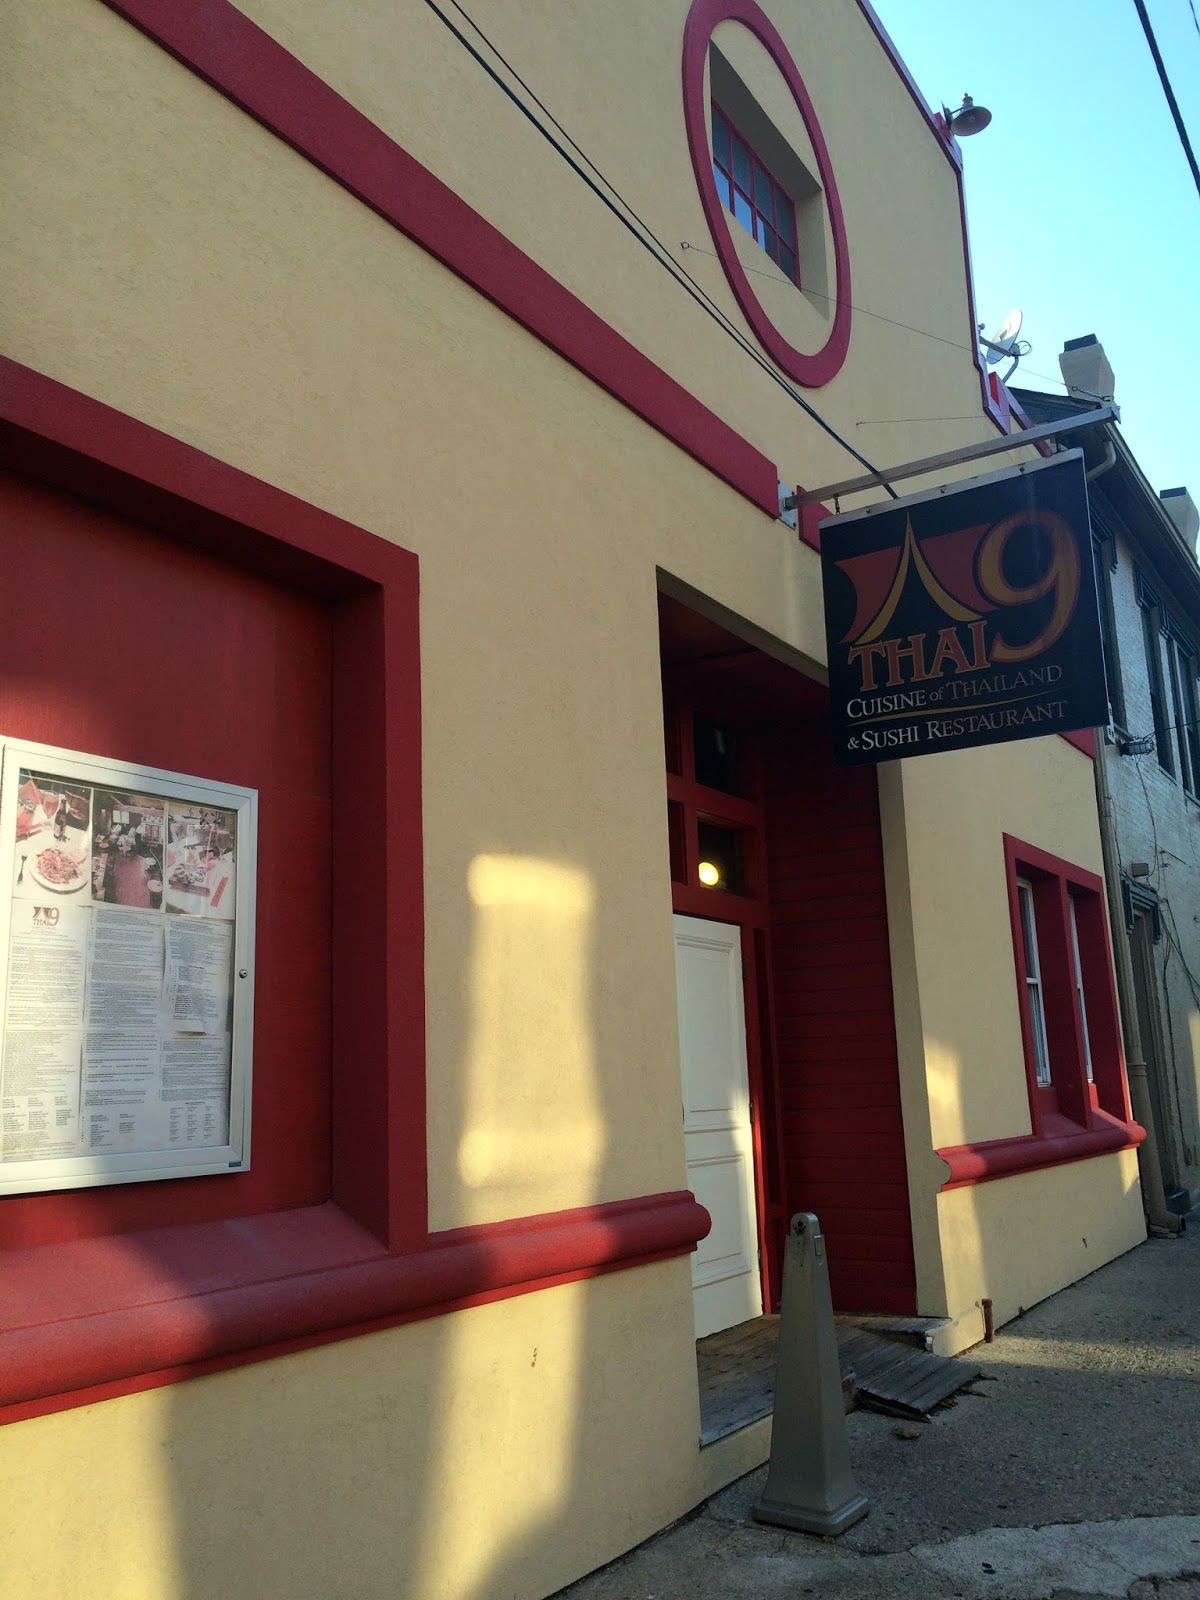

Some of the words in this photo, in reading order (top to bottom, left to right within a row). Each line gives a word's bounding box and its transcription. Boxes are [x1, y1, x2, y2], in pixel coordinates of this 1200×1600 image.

[848, 620, 991, 692] THAI
[978, 508, 1081, 663] 9
[846, 690, 926, 719] CUISINE
[929, 687, 944, 701] of
[946, 665, 1062, 700] THAILAND
[847, 737, 860, 750] &
[862, 726, 920, 750] SUSHI
[927, 701, 1068, 740] RESTAURANT
